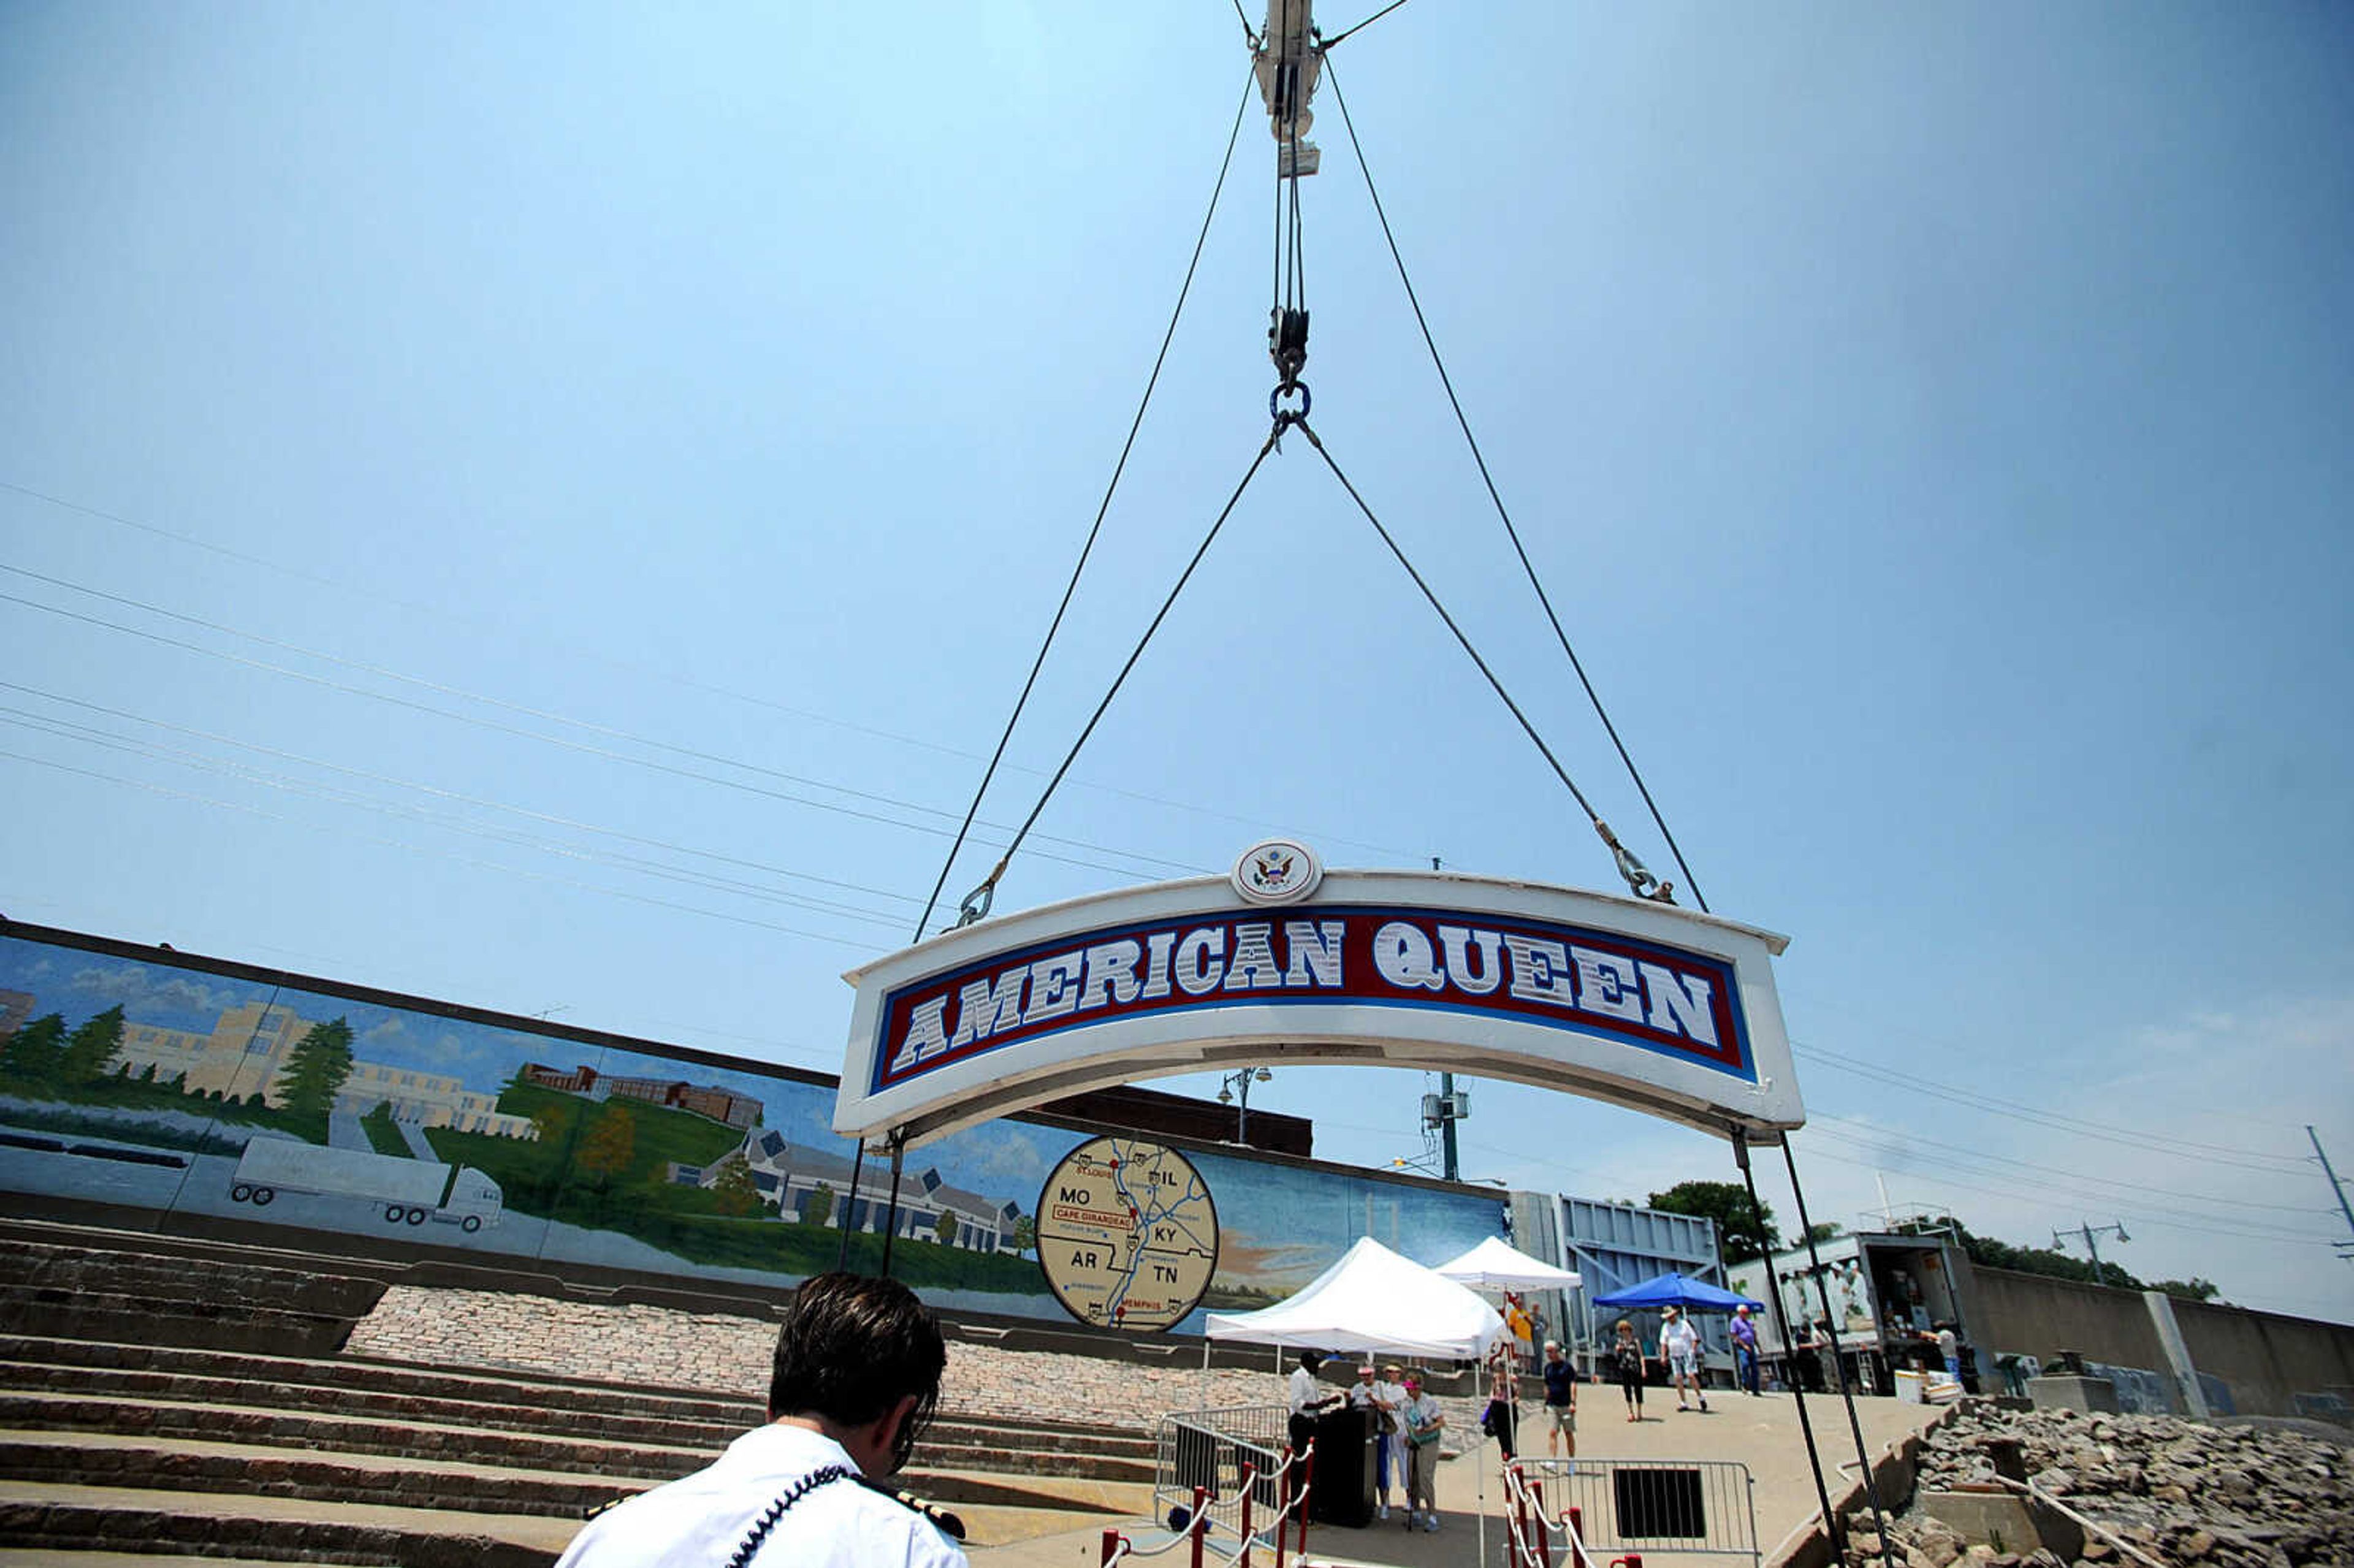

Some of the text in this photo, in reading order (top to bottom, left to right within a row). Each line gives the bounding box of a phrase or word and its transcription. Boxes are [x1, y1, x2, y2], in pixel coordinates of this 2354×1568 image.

[889, 921, 1719, 1076] AMERICAN QUEEN
[1162, 1171, 1178, 1186] IL
[1060, 1187, 1090, 1205] MO
[1057, 1209, 1079, 1217] CAPE
[1155, 1227, 1176, 1242] KY
[1071, 1250, 1097, 1269] AR
[1153, 1265, 1178, 1284] TN
